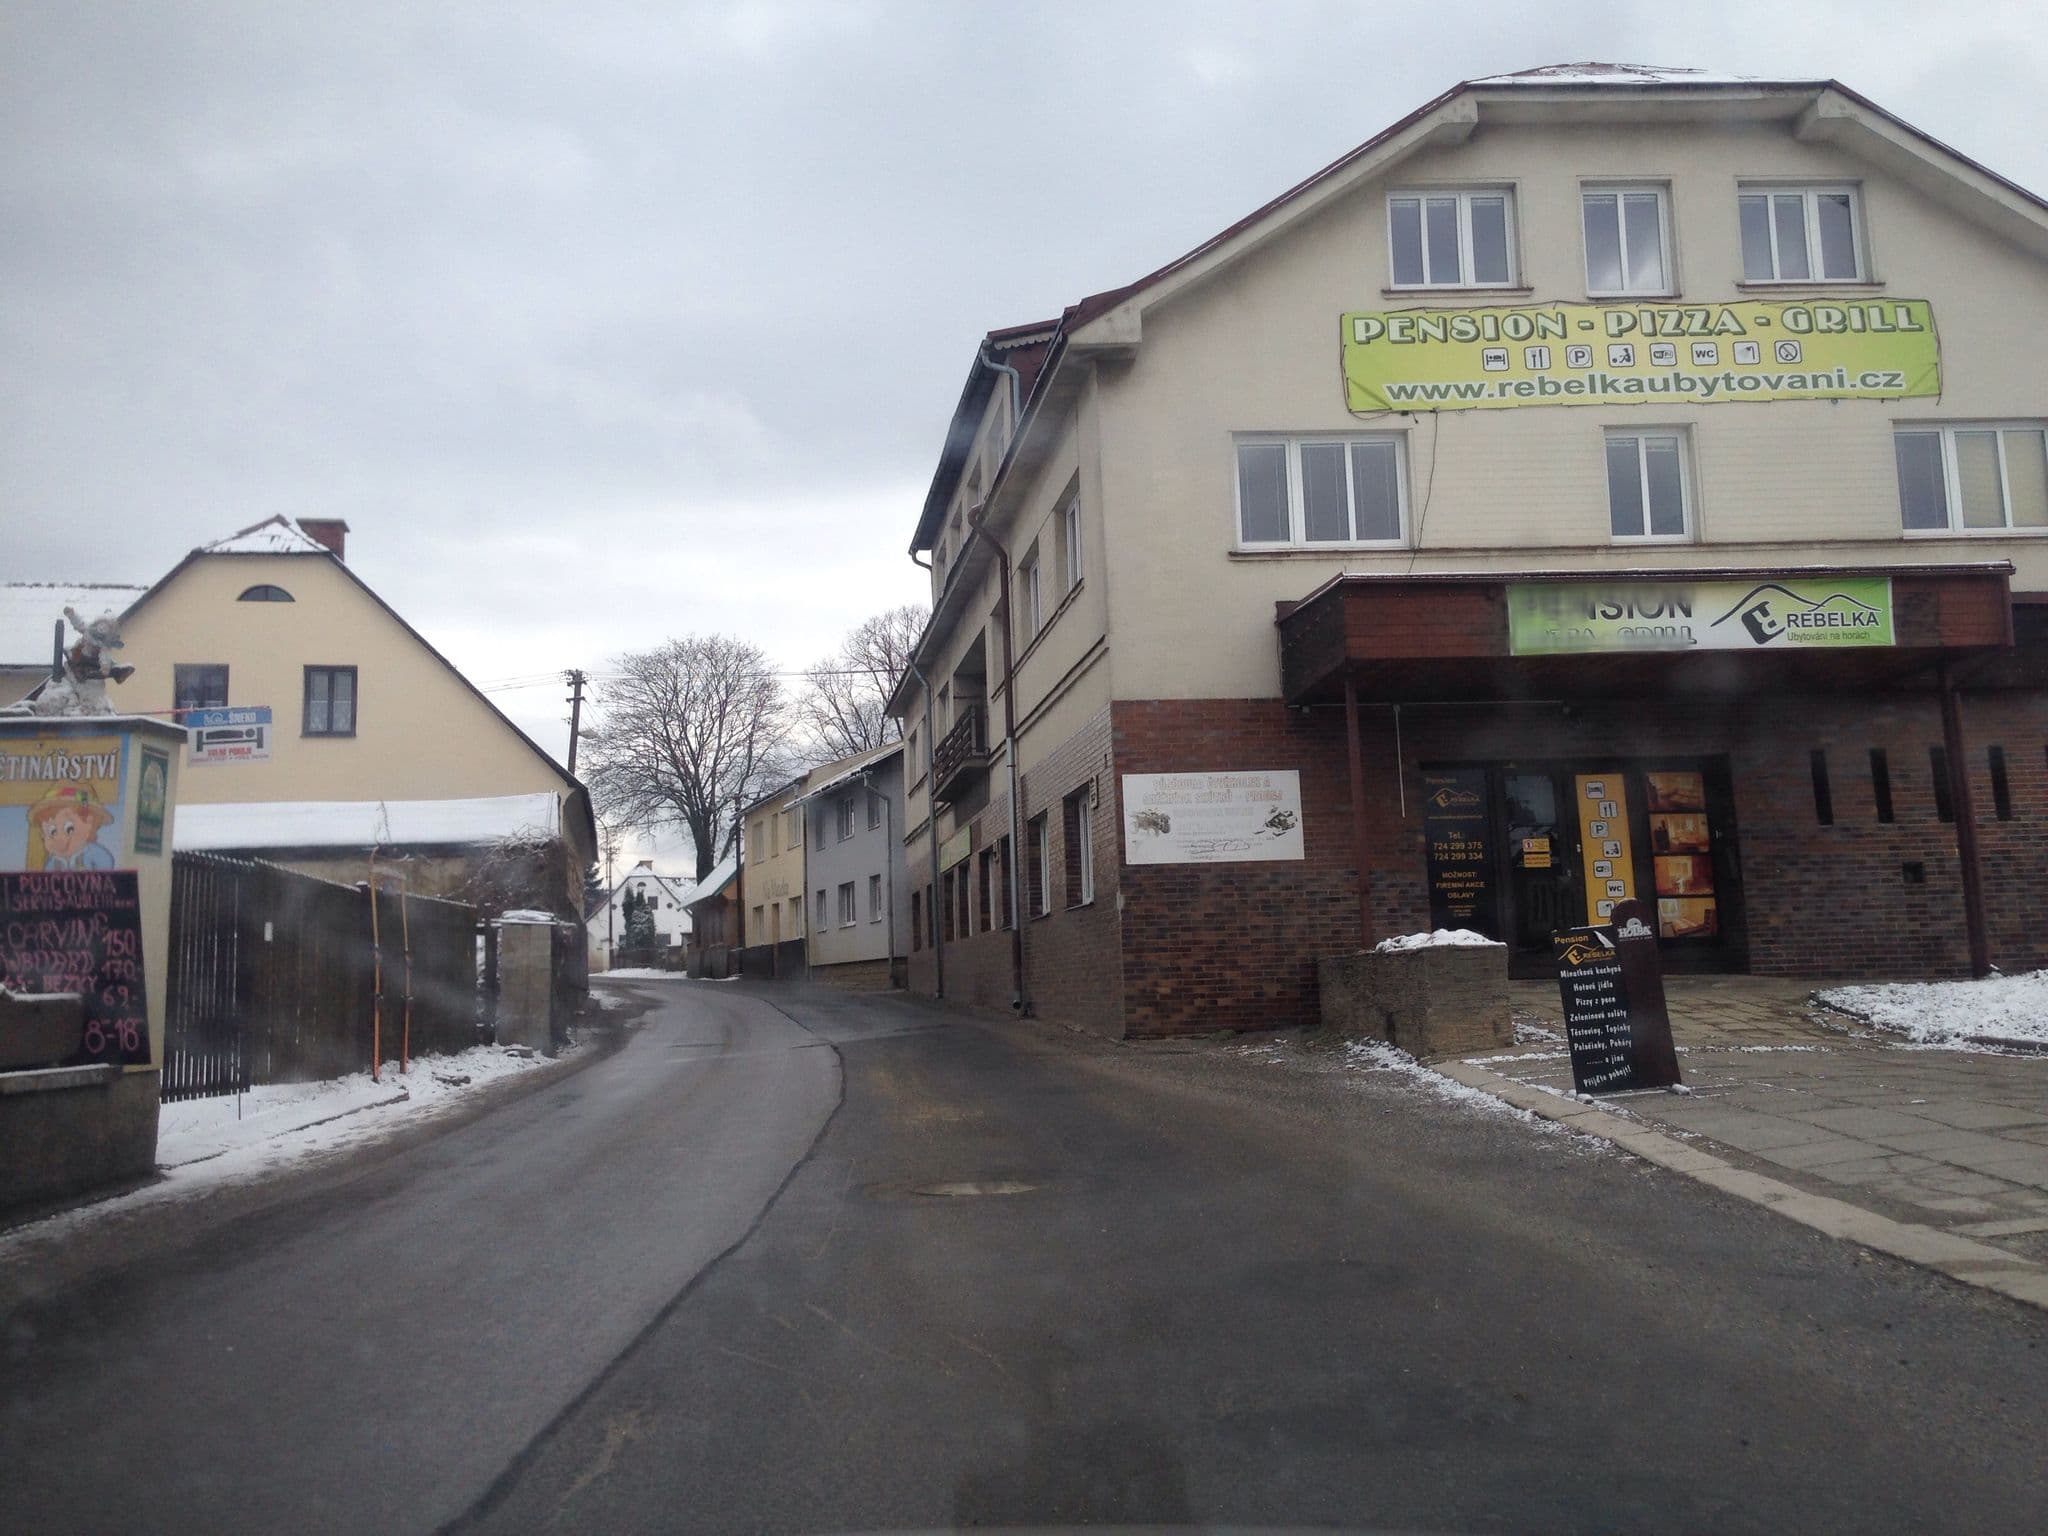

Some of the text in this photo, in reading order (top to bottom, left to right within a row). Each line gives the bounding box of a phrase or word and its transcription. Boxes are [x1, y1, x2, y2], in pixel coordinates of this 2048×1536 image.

[1353, 311, 1568, 345] PENSION
[1604, 308, 1747, 337] PIZZA
[1781, 304, 1924, 333] GRILL
[1695, 350, 1714, 358] WC
[1386, 368, 1904, 400] www.rebelkaubytovani.cz
[1787, 611, 1879, 628] REBELKA
[1433, 842, 1448, 850] 724
[1434, 853, 1449, 861] 724
[1608, 884, 1623, 893] WC
[1554, 934, 1589, 944] Pension
